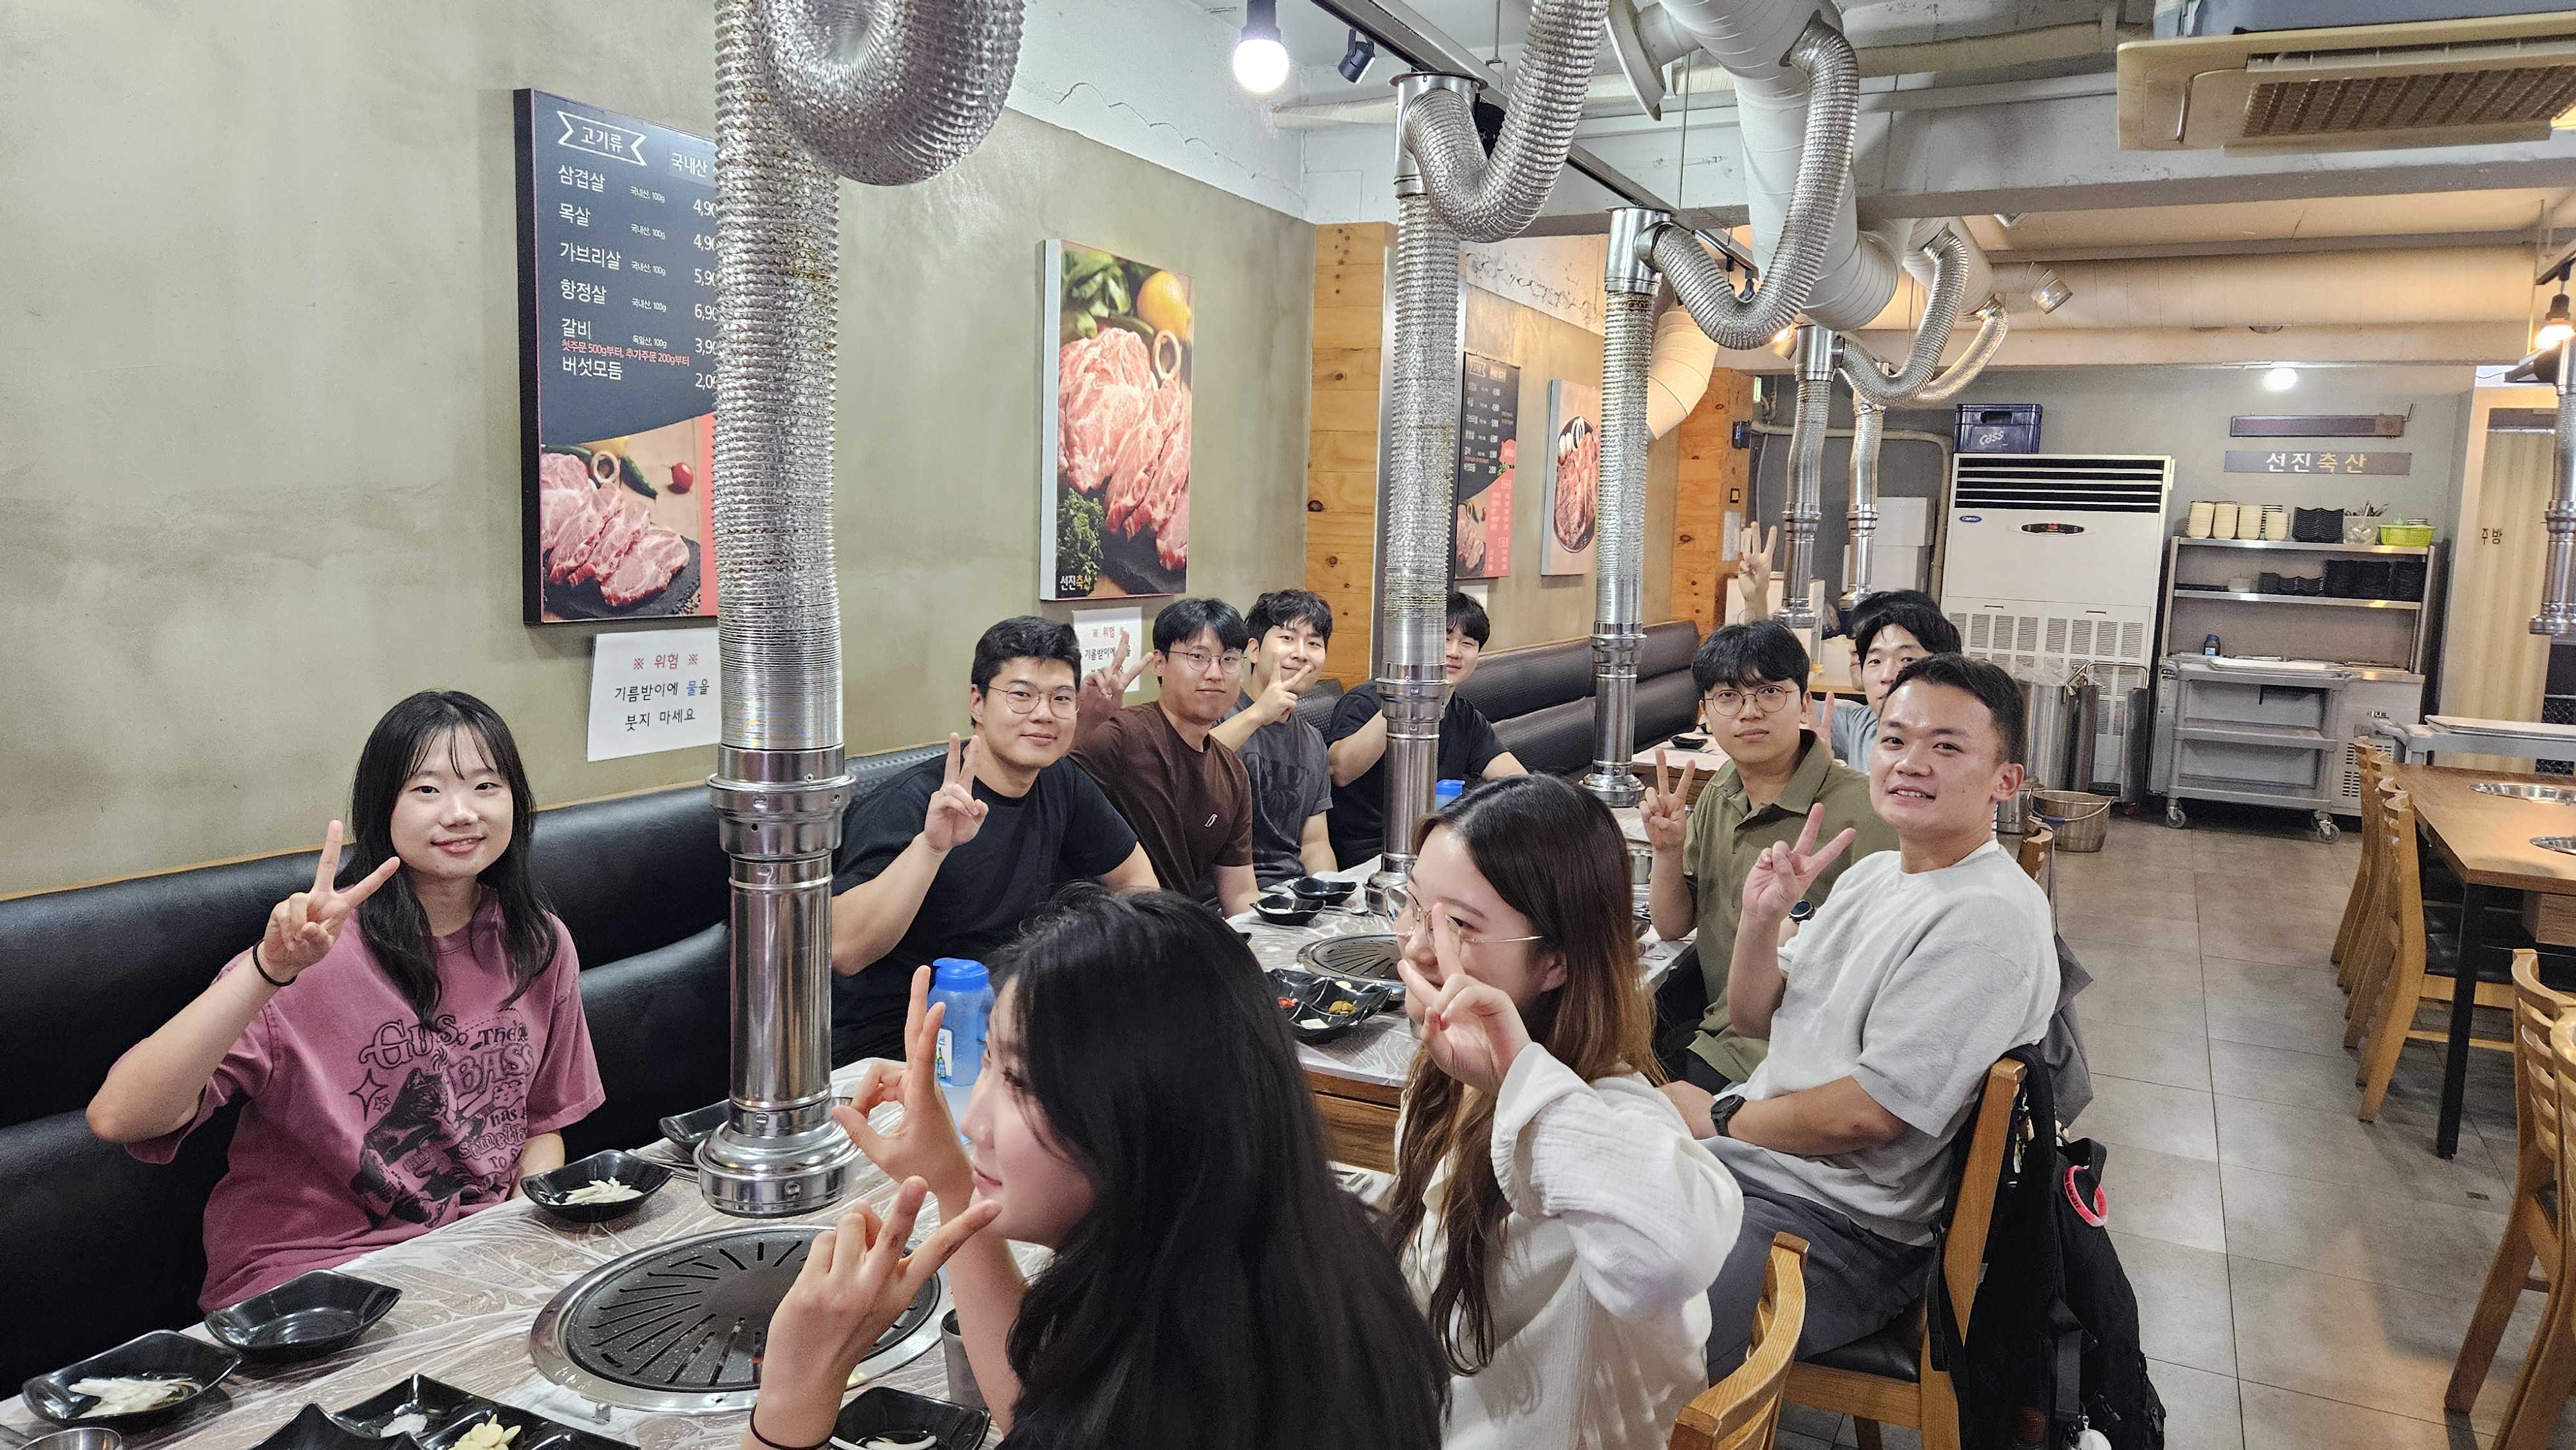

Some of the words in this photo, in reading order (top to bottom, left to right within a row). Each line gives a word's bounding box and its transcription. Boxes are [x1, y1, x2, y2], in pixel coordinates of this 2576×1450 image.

[581, 126, 623, 153] 고기류
[670, 152, 708, 177] 국내산
[558, 164, 605, 193] 삼겹살
[652, 193, 665, 203] 100g
[559, 203, 591, 227] 목살
[652, 229, 665, 240] 100g
[560, 242, 621, 270] 가브리살
[653, 265, 666, 276] 100g
[560, 279, 607, 305] 항정살
[654, 302, 667, 313] 100g
[562, 318, 591, 340] 갈비
[654, 338, 667, 349] 100g
[562, 339, 587, 353] 첫주문
[626, 348, 657, 362] 추가주문
[658, 353, 690, 367] 200g부터
[562, 357, 623, 381] 버섯모듬
[1979, 430, 2005, 446] Cass
[2266, 452, 2368, 474] 선진축산
[2481, 528, 2503, 545] 주방
[1060, 574, 1092, 590] 선진축산
[654, 654, 678, 670] 위험
[614, 682, 678, 702] 기름받이에
[686, 679, 710, 696] 물을
[625, 712, 650, 731] 붓지
[659, 708, 696, 724] 마세요
[359, 1015, 459, 1069] GUS
[448, 1043, 535, 1097] BASS
[490, 1108, 517, 1127] has
